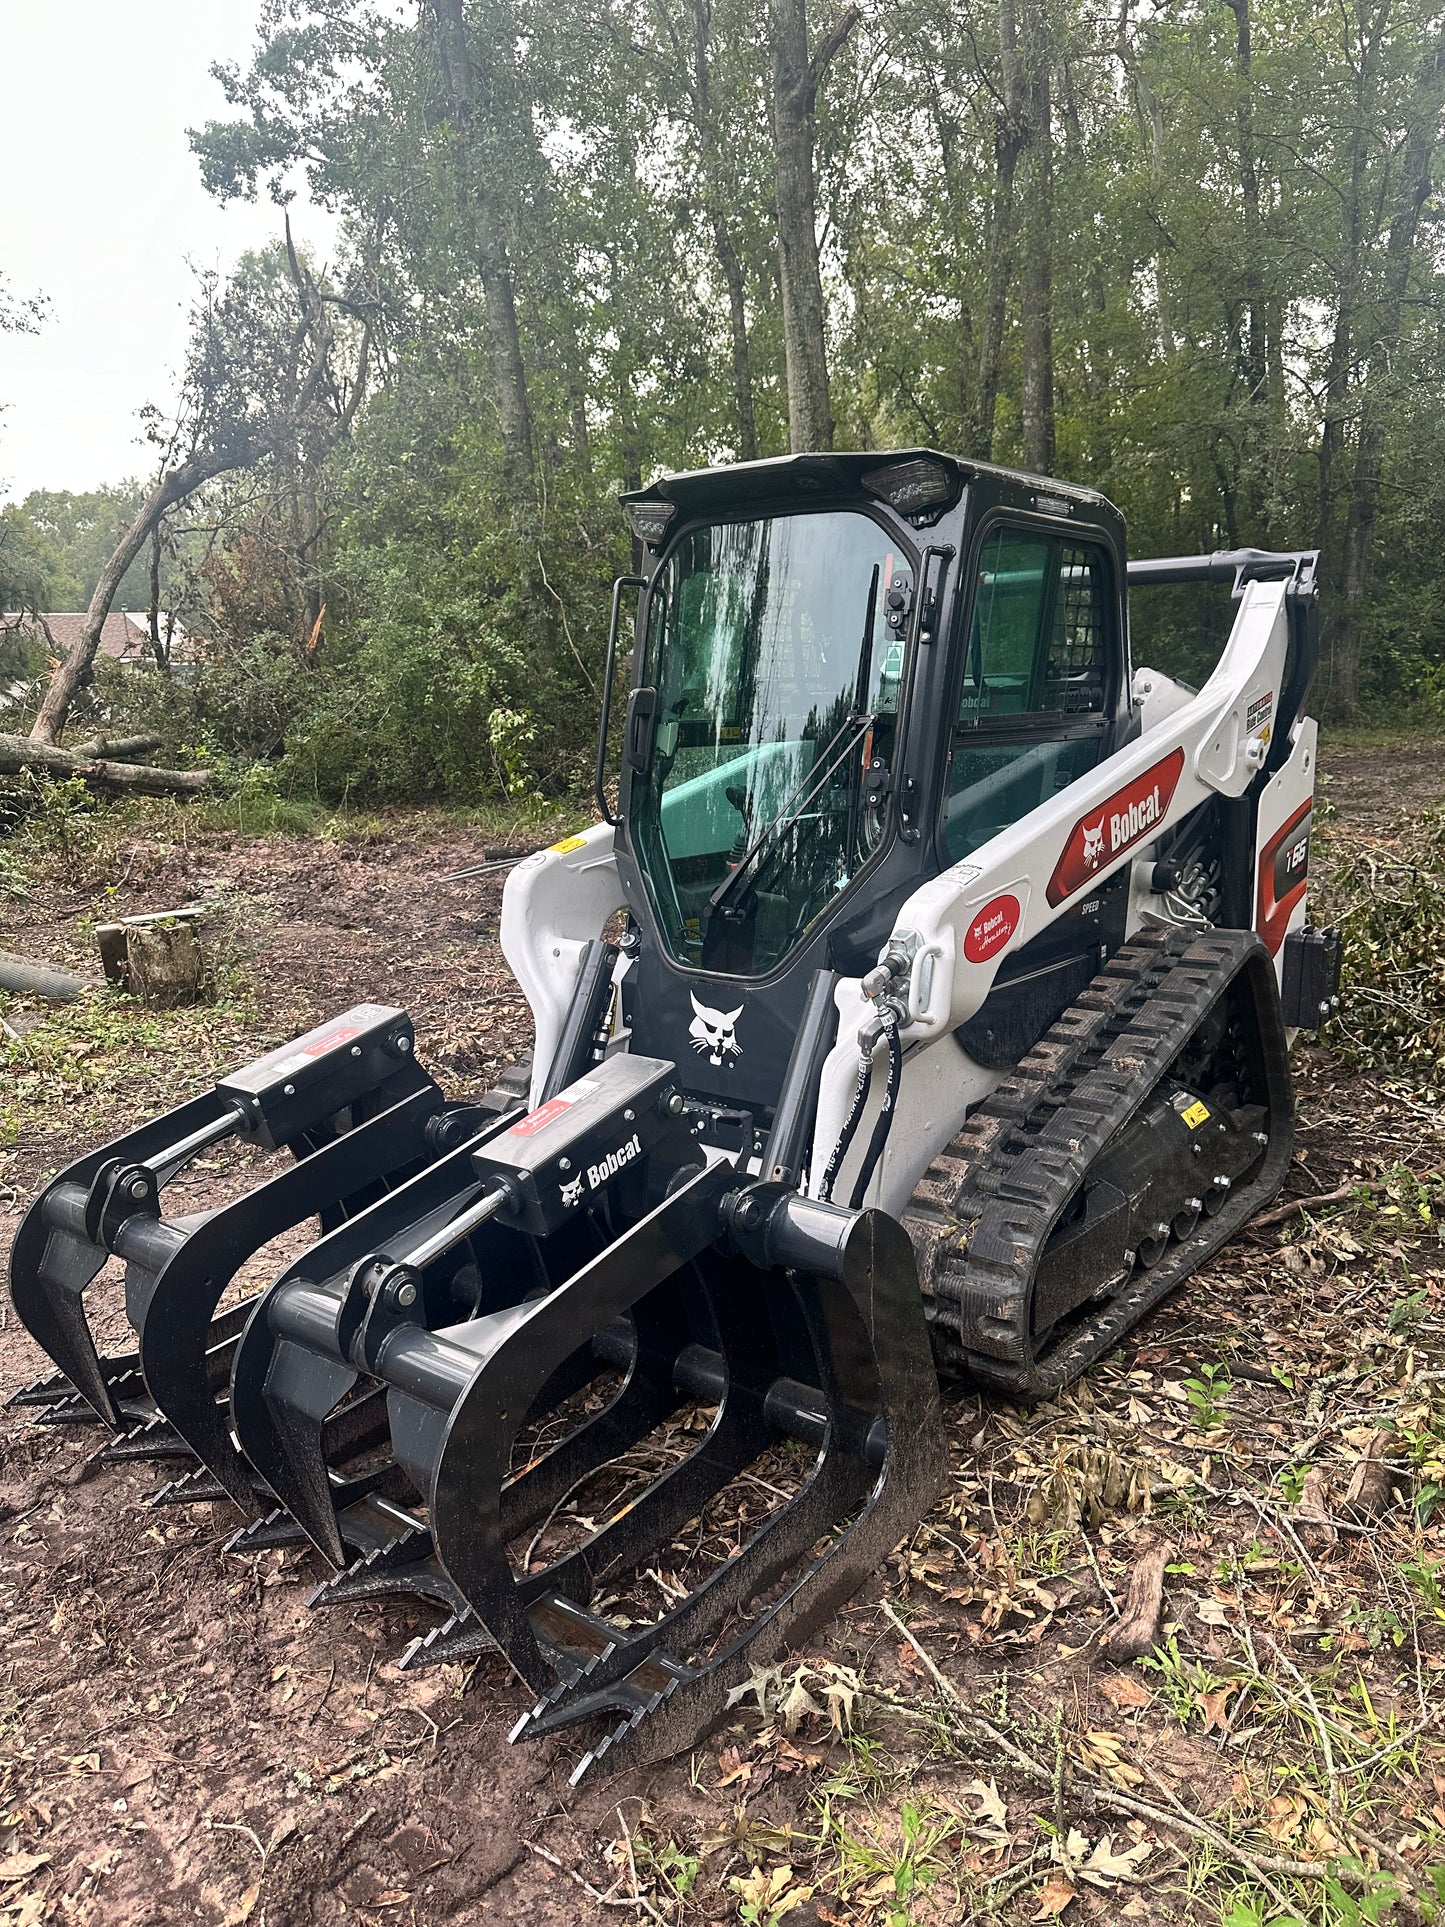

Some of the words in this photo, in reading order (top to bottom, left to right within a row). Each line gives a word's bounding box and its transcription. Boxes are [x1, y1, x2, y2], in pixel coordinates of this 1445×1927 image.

[962, 696, 991, 708] obcat
[1110, 784, 1160, 852] Bobcat
[1286, 837, 1307, 873] T66
[983, 910, 1003, 935] Bobcat
[1081, 900, 1100, 915] SPEED
[586, 1133, 642, 1190] Bobcat
